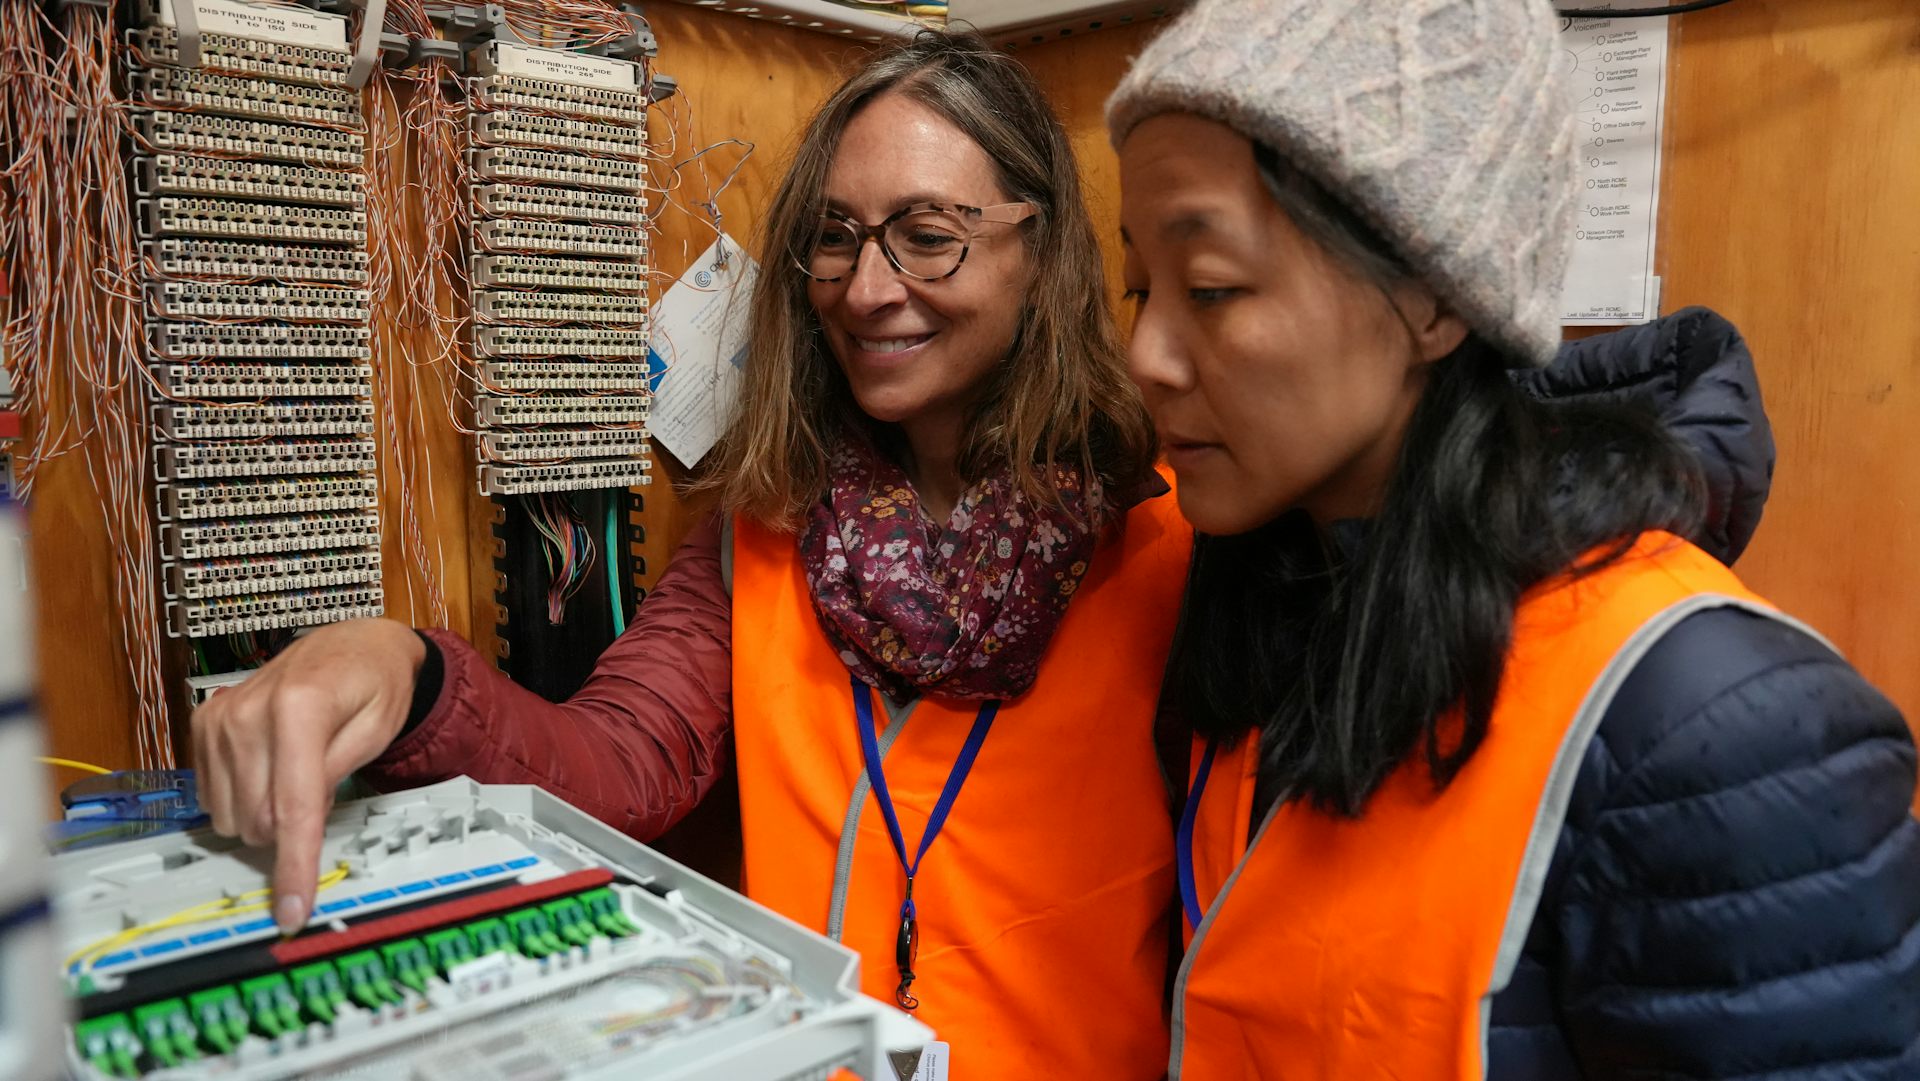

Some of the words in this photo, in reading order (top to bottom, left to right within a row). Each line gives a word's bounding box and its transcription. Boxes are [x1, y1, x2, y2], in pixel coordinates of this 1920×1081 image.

[199, 7, 285, 25] DISTRIBUTION
[291, 21, 318, 31] SIDE
[1574, 20, 1610, 32] Voicemail
[267, 24, 286, 32] 150
[526, 58, 588, 72] DISTRIBUTION
[593, 68, 612, 76] SIDE
